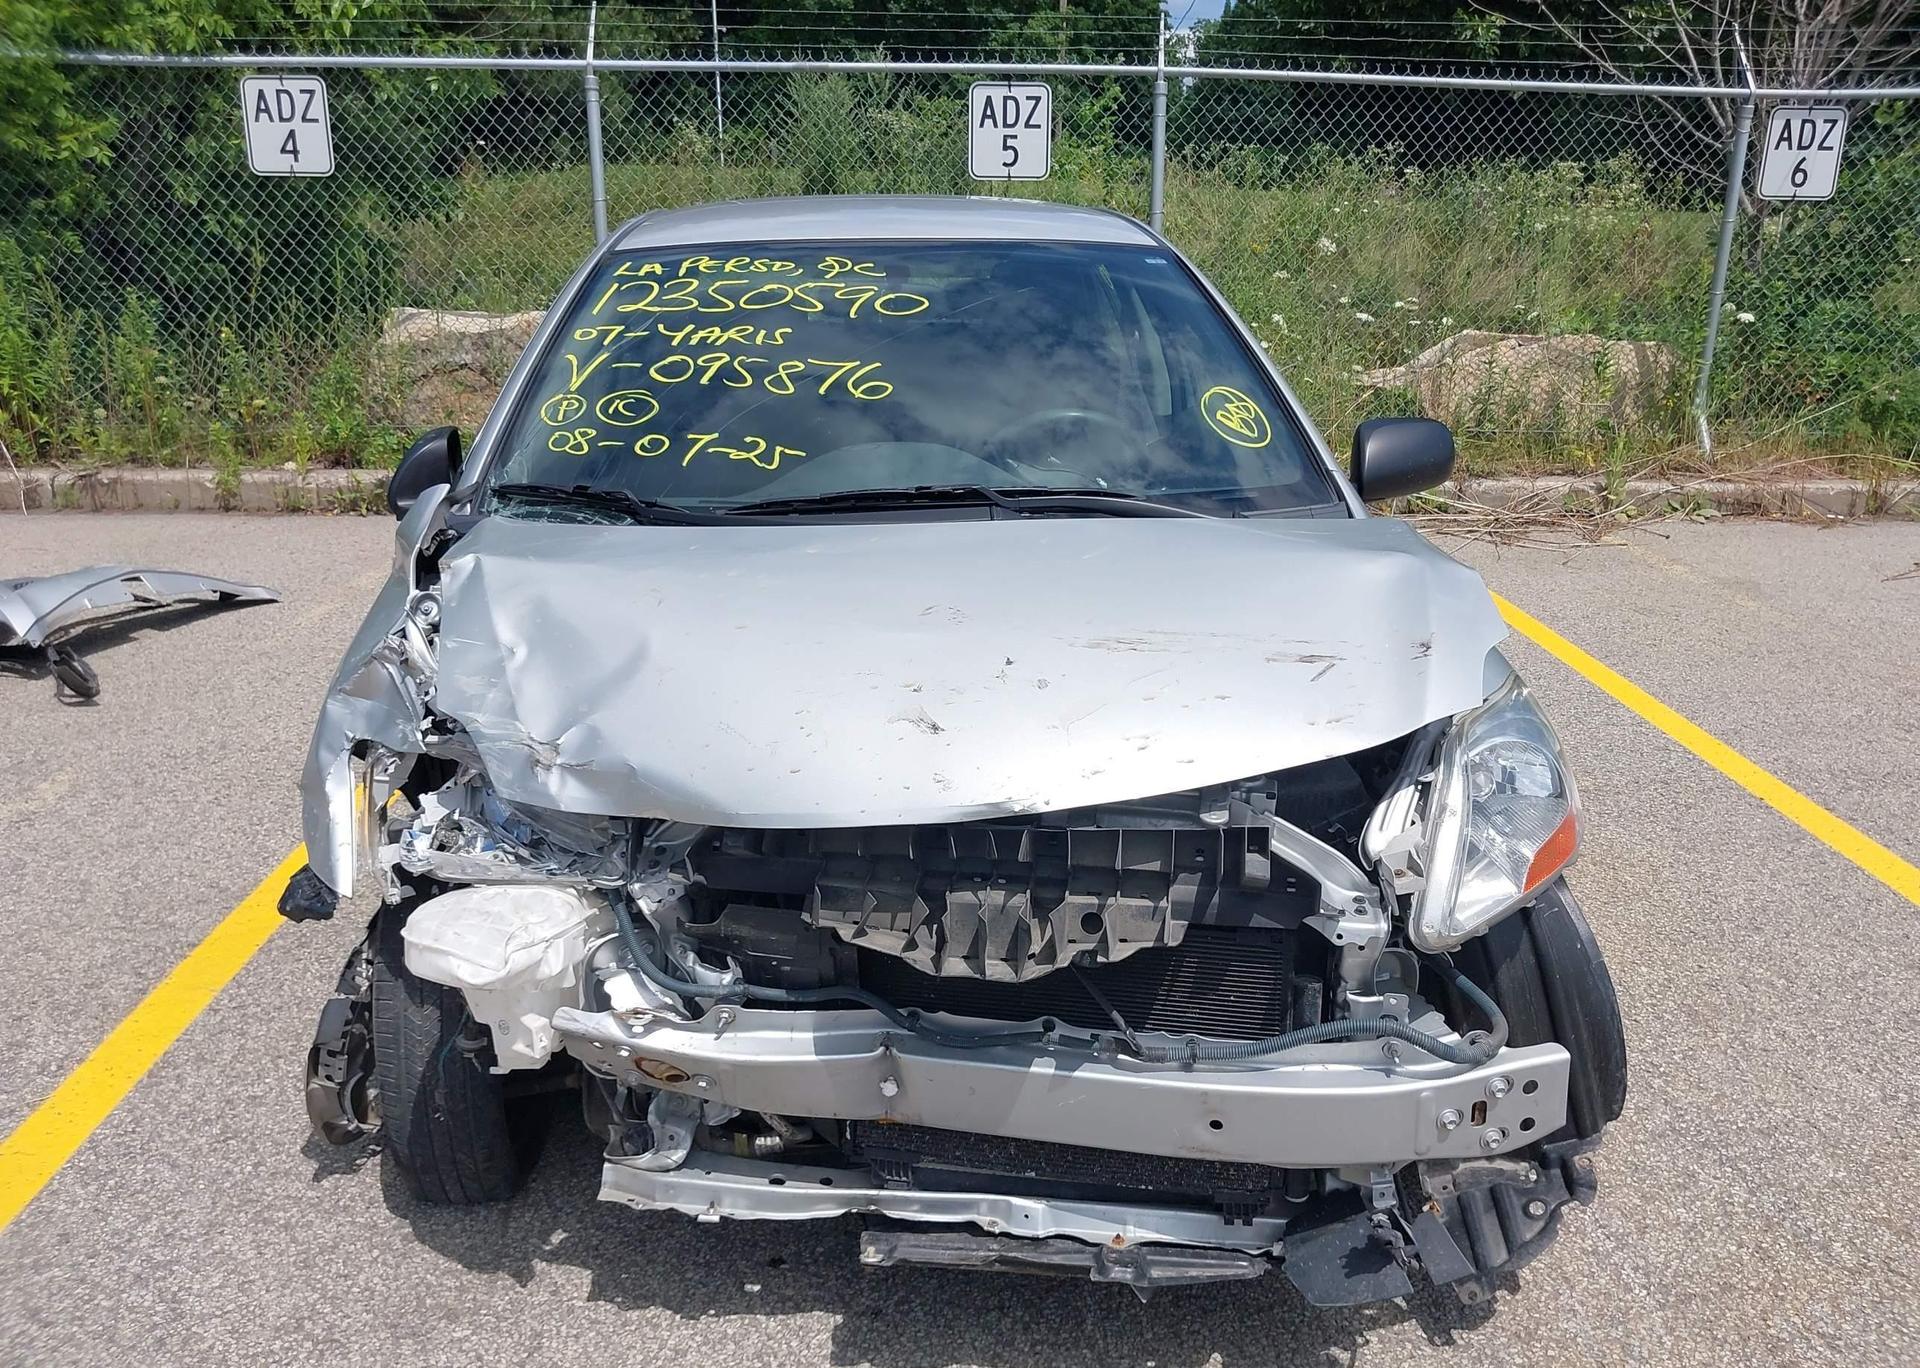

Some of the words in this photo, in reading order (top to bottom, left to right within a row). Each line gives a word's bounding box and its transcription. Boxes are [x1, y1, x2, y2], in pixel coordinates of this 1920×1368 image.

[254, 88, 320, 123] ADZ
[979, 95, 1042, 129] ADZ
[280, 128, 300, 163] 4
[1002, 134, 1019, 168] 5
[1774, 118, 1839, 151] ADZ
[1790, 156, 1808, 188] 6
[613, 261, 669, 277] LA
[592, 277, 930, 318] 12350590
